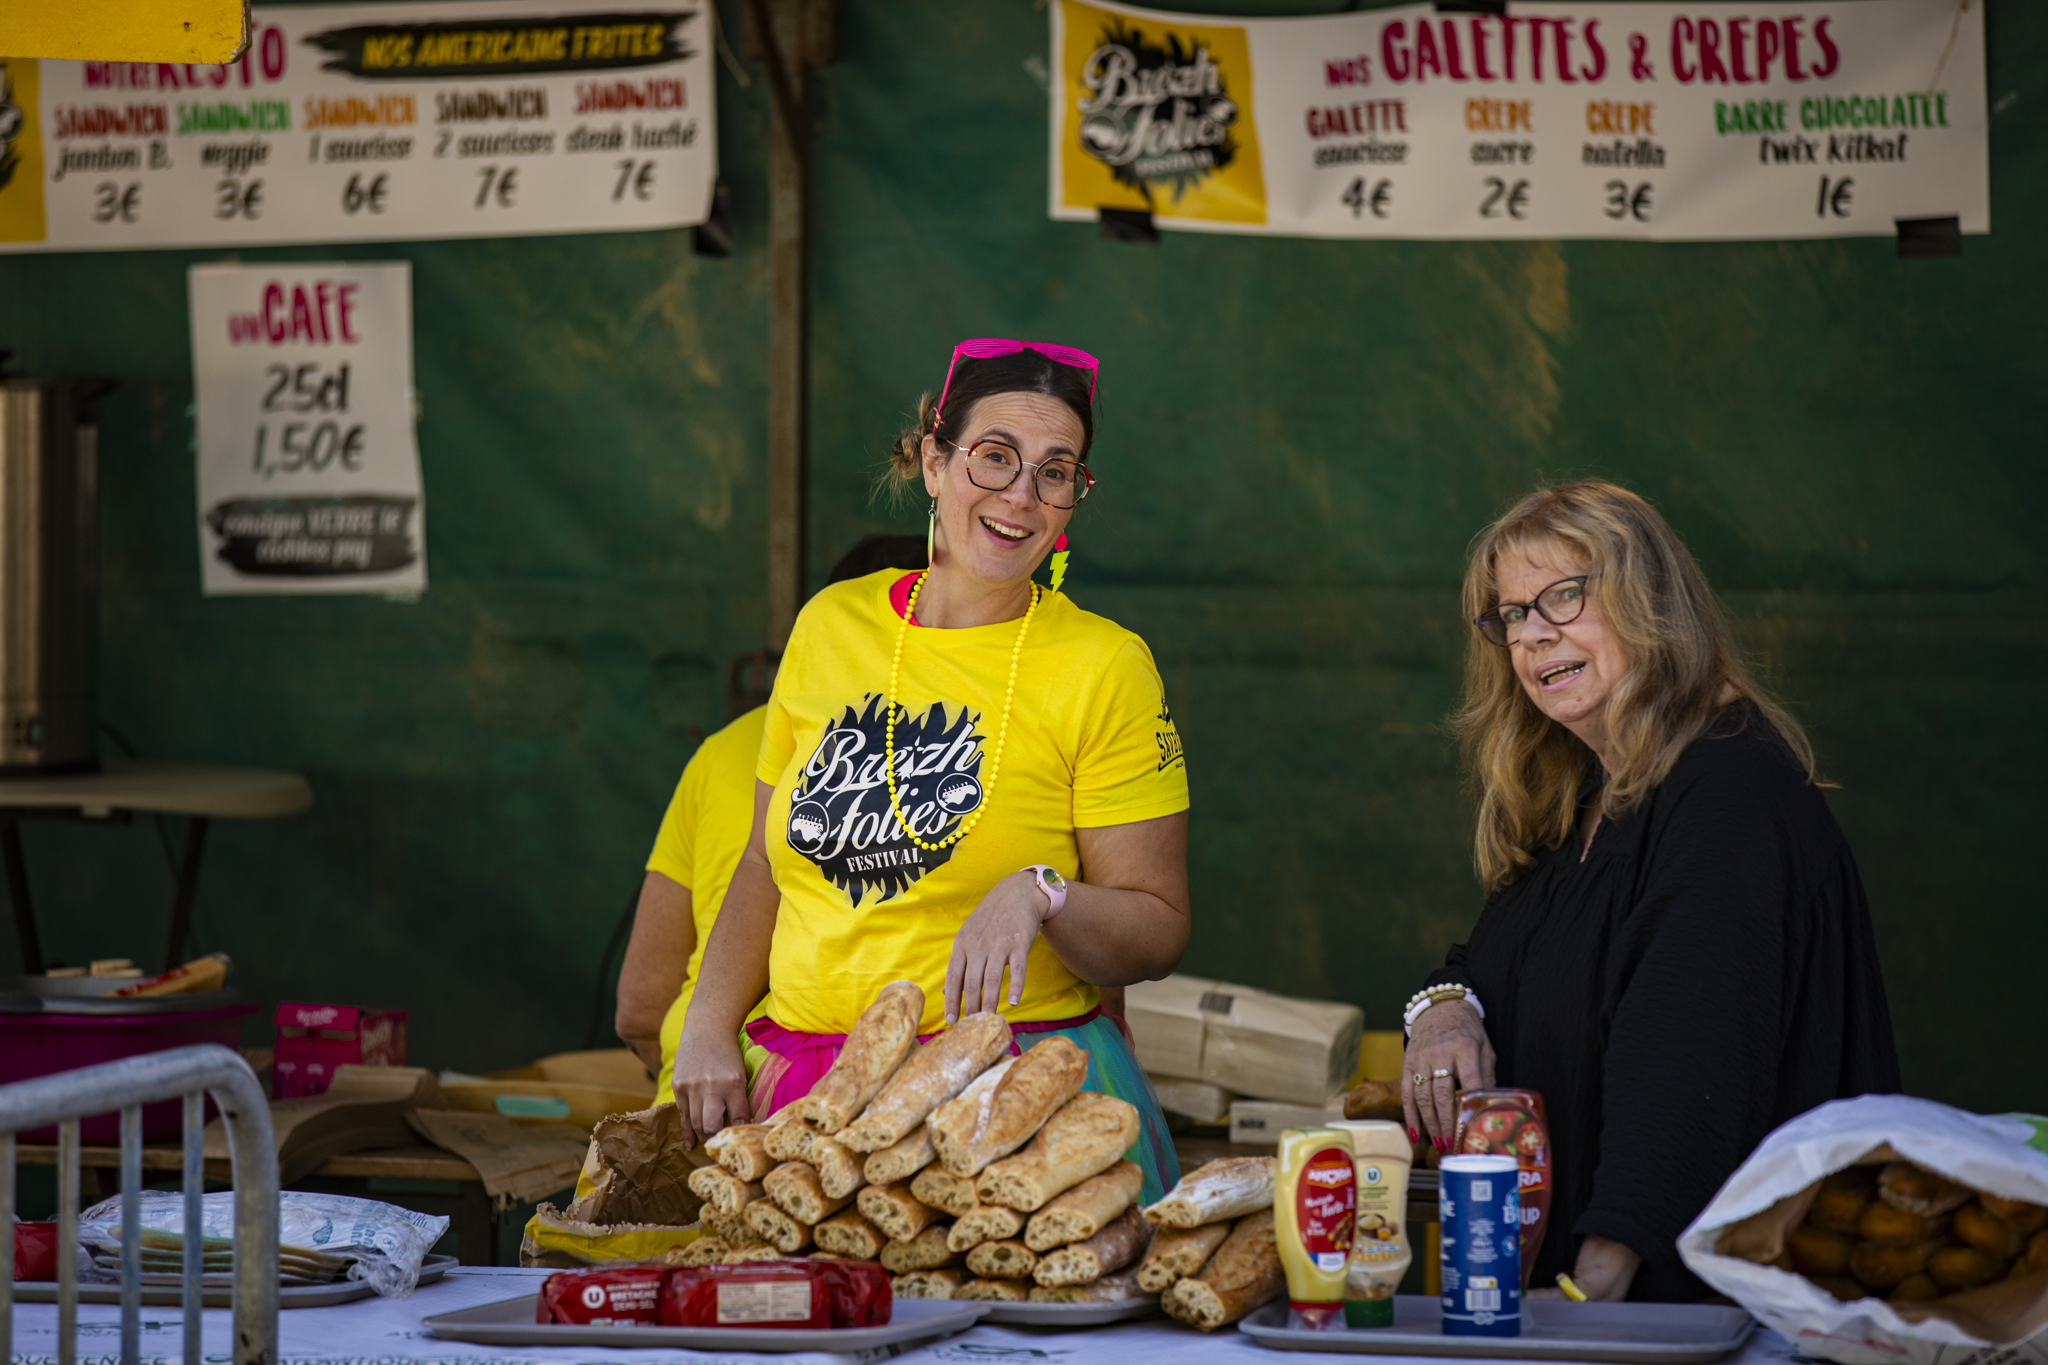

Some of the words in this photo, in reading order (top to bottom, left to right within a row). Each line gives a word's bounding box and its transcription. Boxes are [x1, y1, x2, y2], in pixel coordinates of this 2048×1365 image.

[363, 35, 414, 68] NOS
[572, 25, 665, 59] FRITES
[1326, 55, 1371, 86] NOS
[1382, 16, 1607, 83] GALETTES
[1629, 33, 1656, 82] &
[178, 101, 289, 135] SANDWICH
[306, 93, 417, 130] SANDWICH
[436, 89, 547, 123] SANDWICH
[574, 79, 686, 115] SANDWICH
[1716, 100, 1786, 136] BARRE
[56, 104, 168, 139] SANDWICH
[1307, 101, 1406, 138] GALETTE
[93, 180, 143, 223] 3€
[215, 180, 265, 222] 3€
[342, 171, 390, 215] 6€
[473, 165, 520, 209] 7€
[613, 160, 657, 203] 7€
[1341, 176, 1392, 218] 4€
[1479, 176, 1530, 219] 2€
[1604, 179, 1652, 222] 3€
[1816, 175, 1853, 218] 1€
[254, 420, 365, 480] 1,50€
[791, 722, 984, 802] Breizh
[845, 847, 923, 873] FESTIVAL
[1307, 1167, 1353, 1185] AMORA
[609, 1289, 658, 1302] BRETAGNE
[612, 1300, 655, 1312] DEMI-SEL
